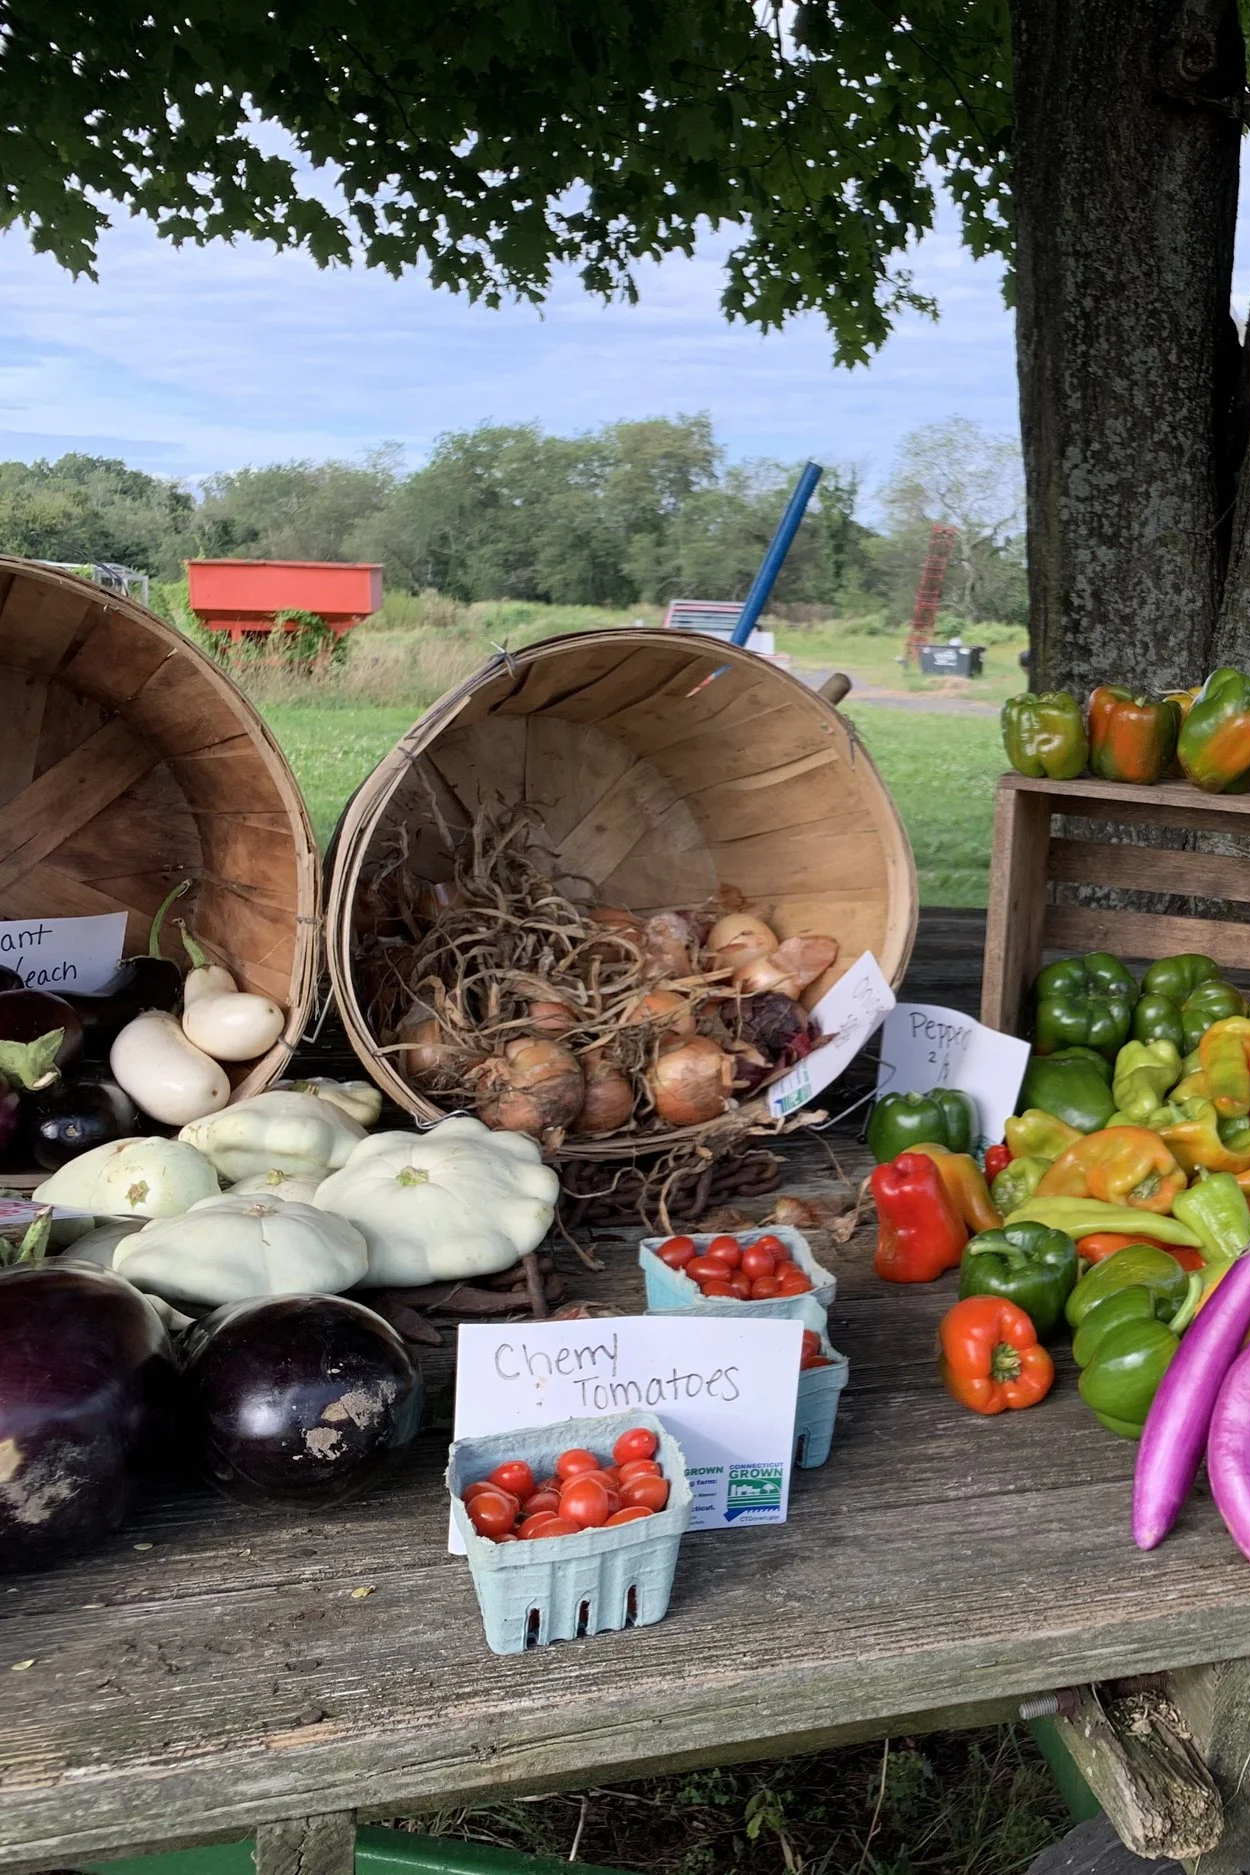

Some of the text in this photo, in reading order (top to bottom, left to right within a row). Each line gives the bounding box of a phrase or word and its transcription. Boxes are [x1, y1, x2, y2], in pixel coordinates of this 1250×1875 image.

[494, 1332, 618, 1380] Cherry
[573, 1366, 740, 1410] Tomatoes
[729, 1462, 784, 1470] CONNECTICUT
[729, 1467, 783, 1480] GROWN
